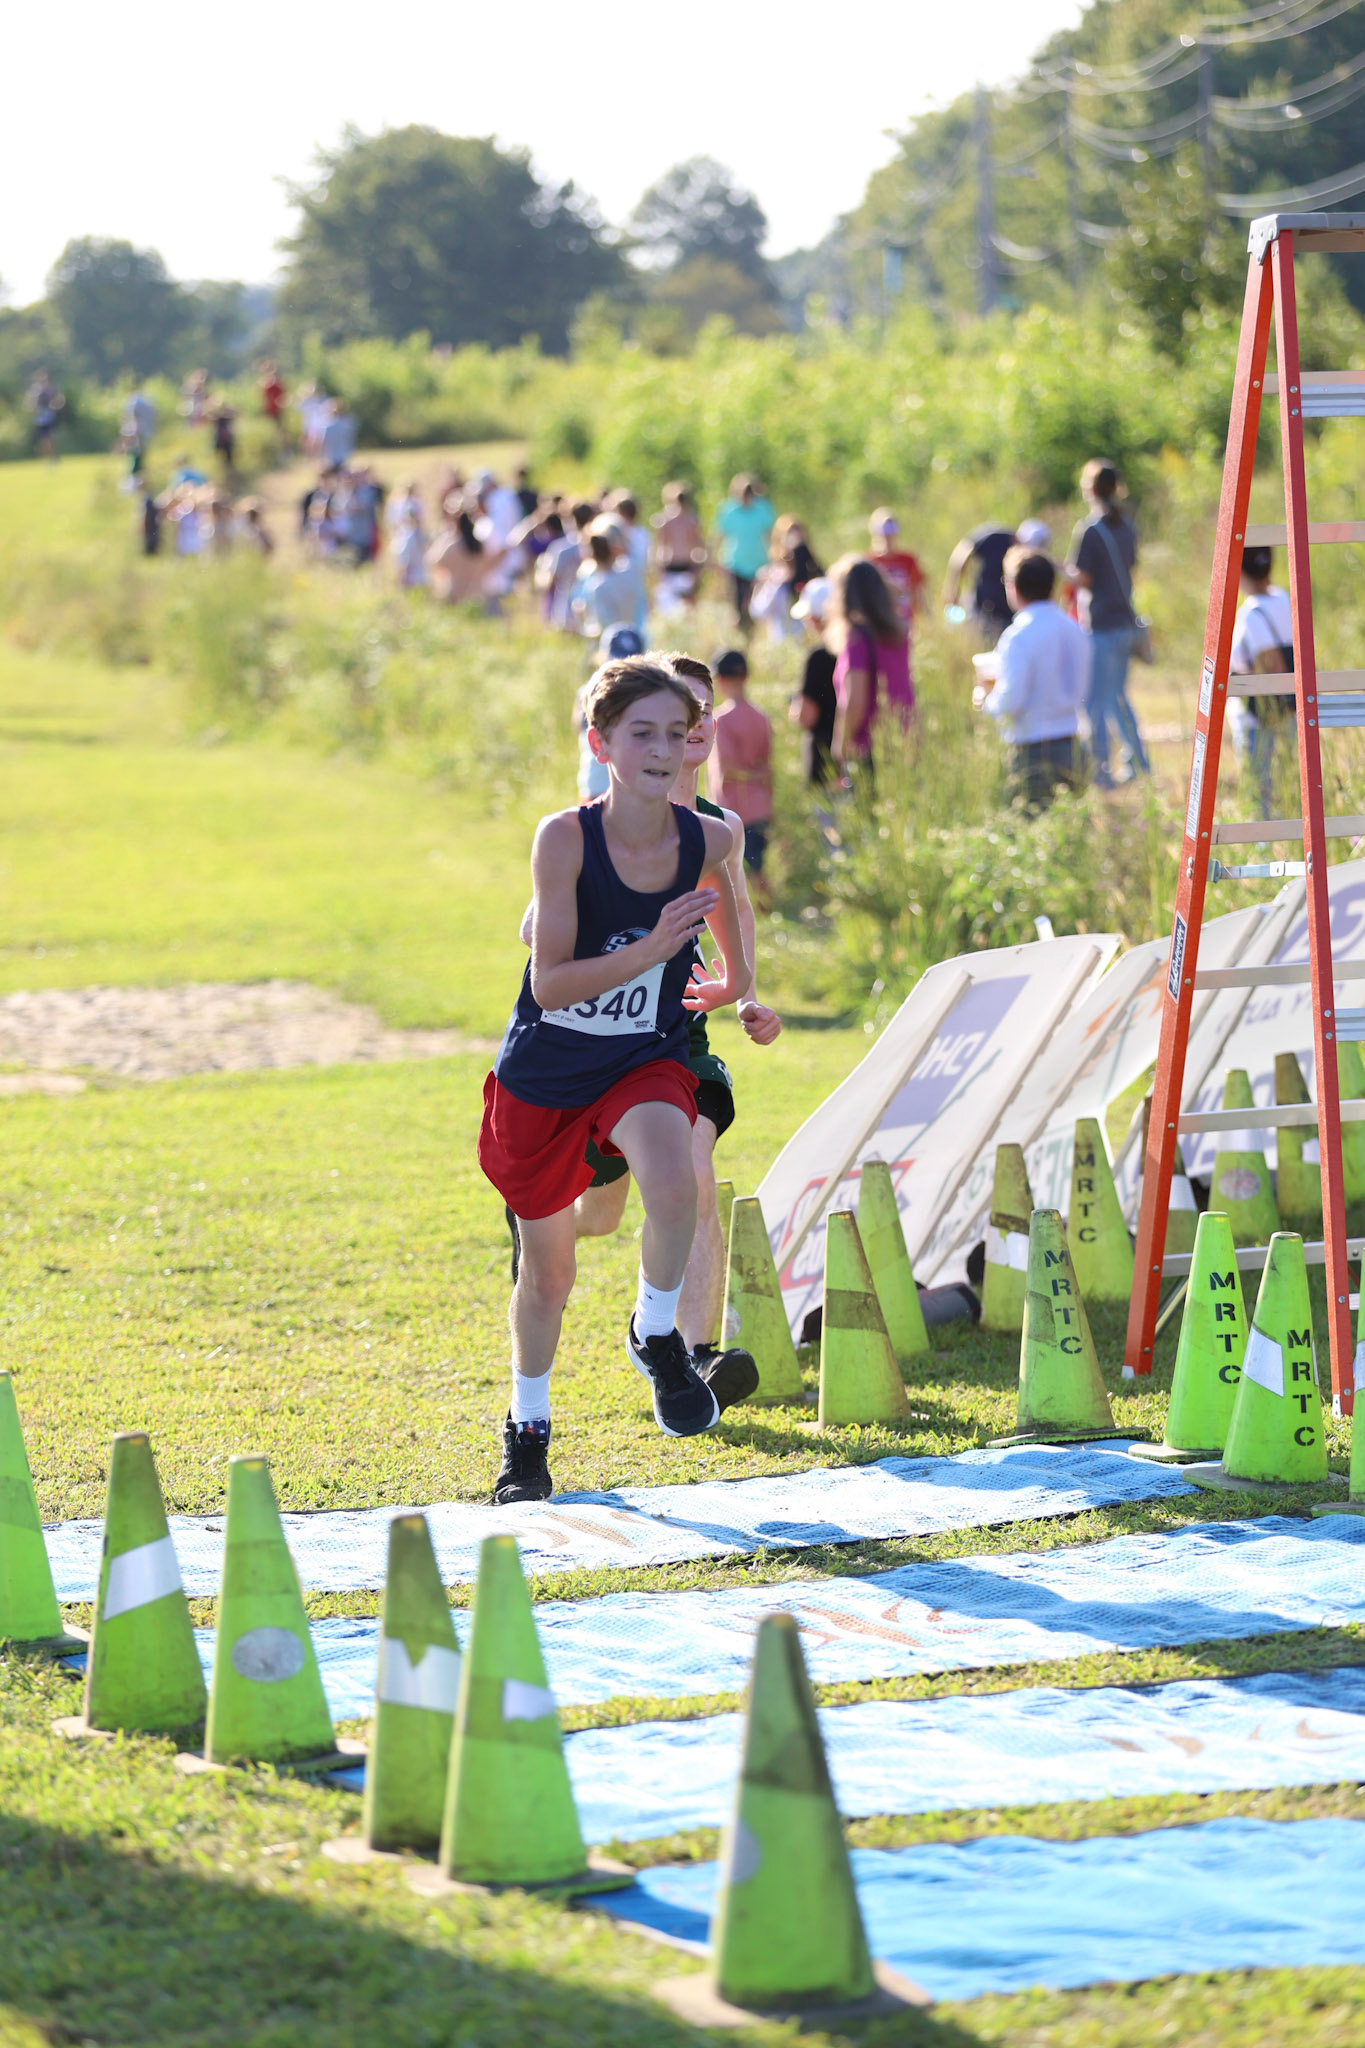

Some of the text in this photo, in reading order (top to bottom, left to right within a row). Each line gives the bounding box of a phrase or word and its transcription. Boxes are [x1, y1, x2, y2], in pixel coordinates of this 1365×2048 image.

[1074, 1153, 1098, 1243] MRTC
[1044, 1250, 1083, 1355] MRTC
[1209, 1272, 1242, 1384] MRTC
[1287, 1329, 1316, 1447] MRTC
